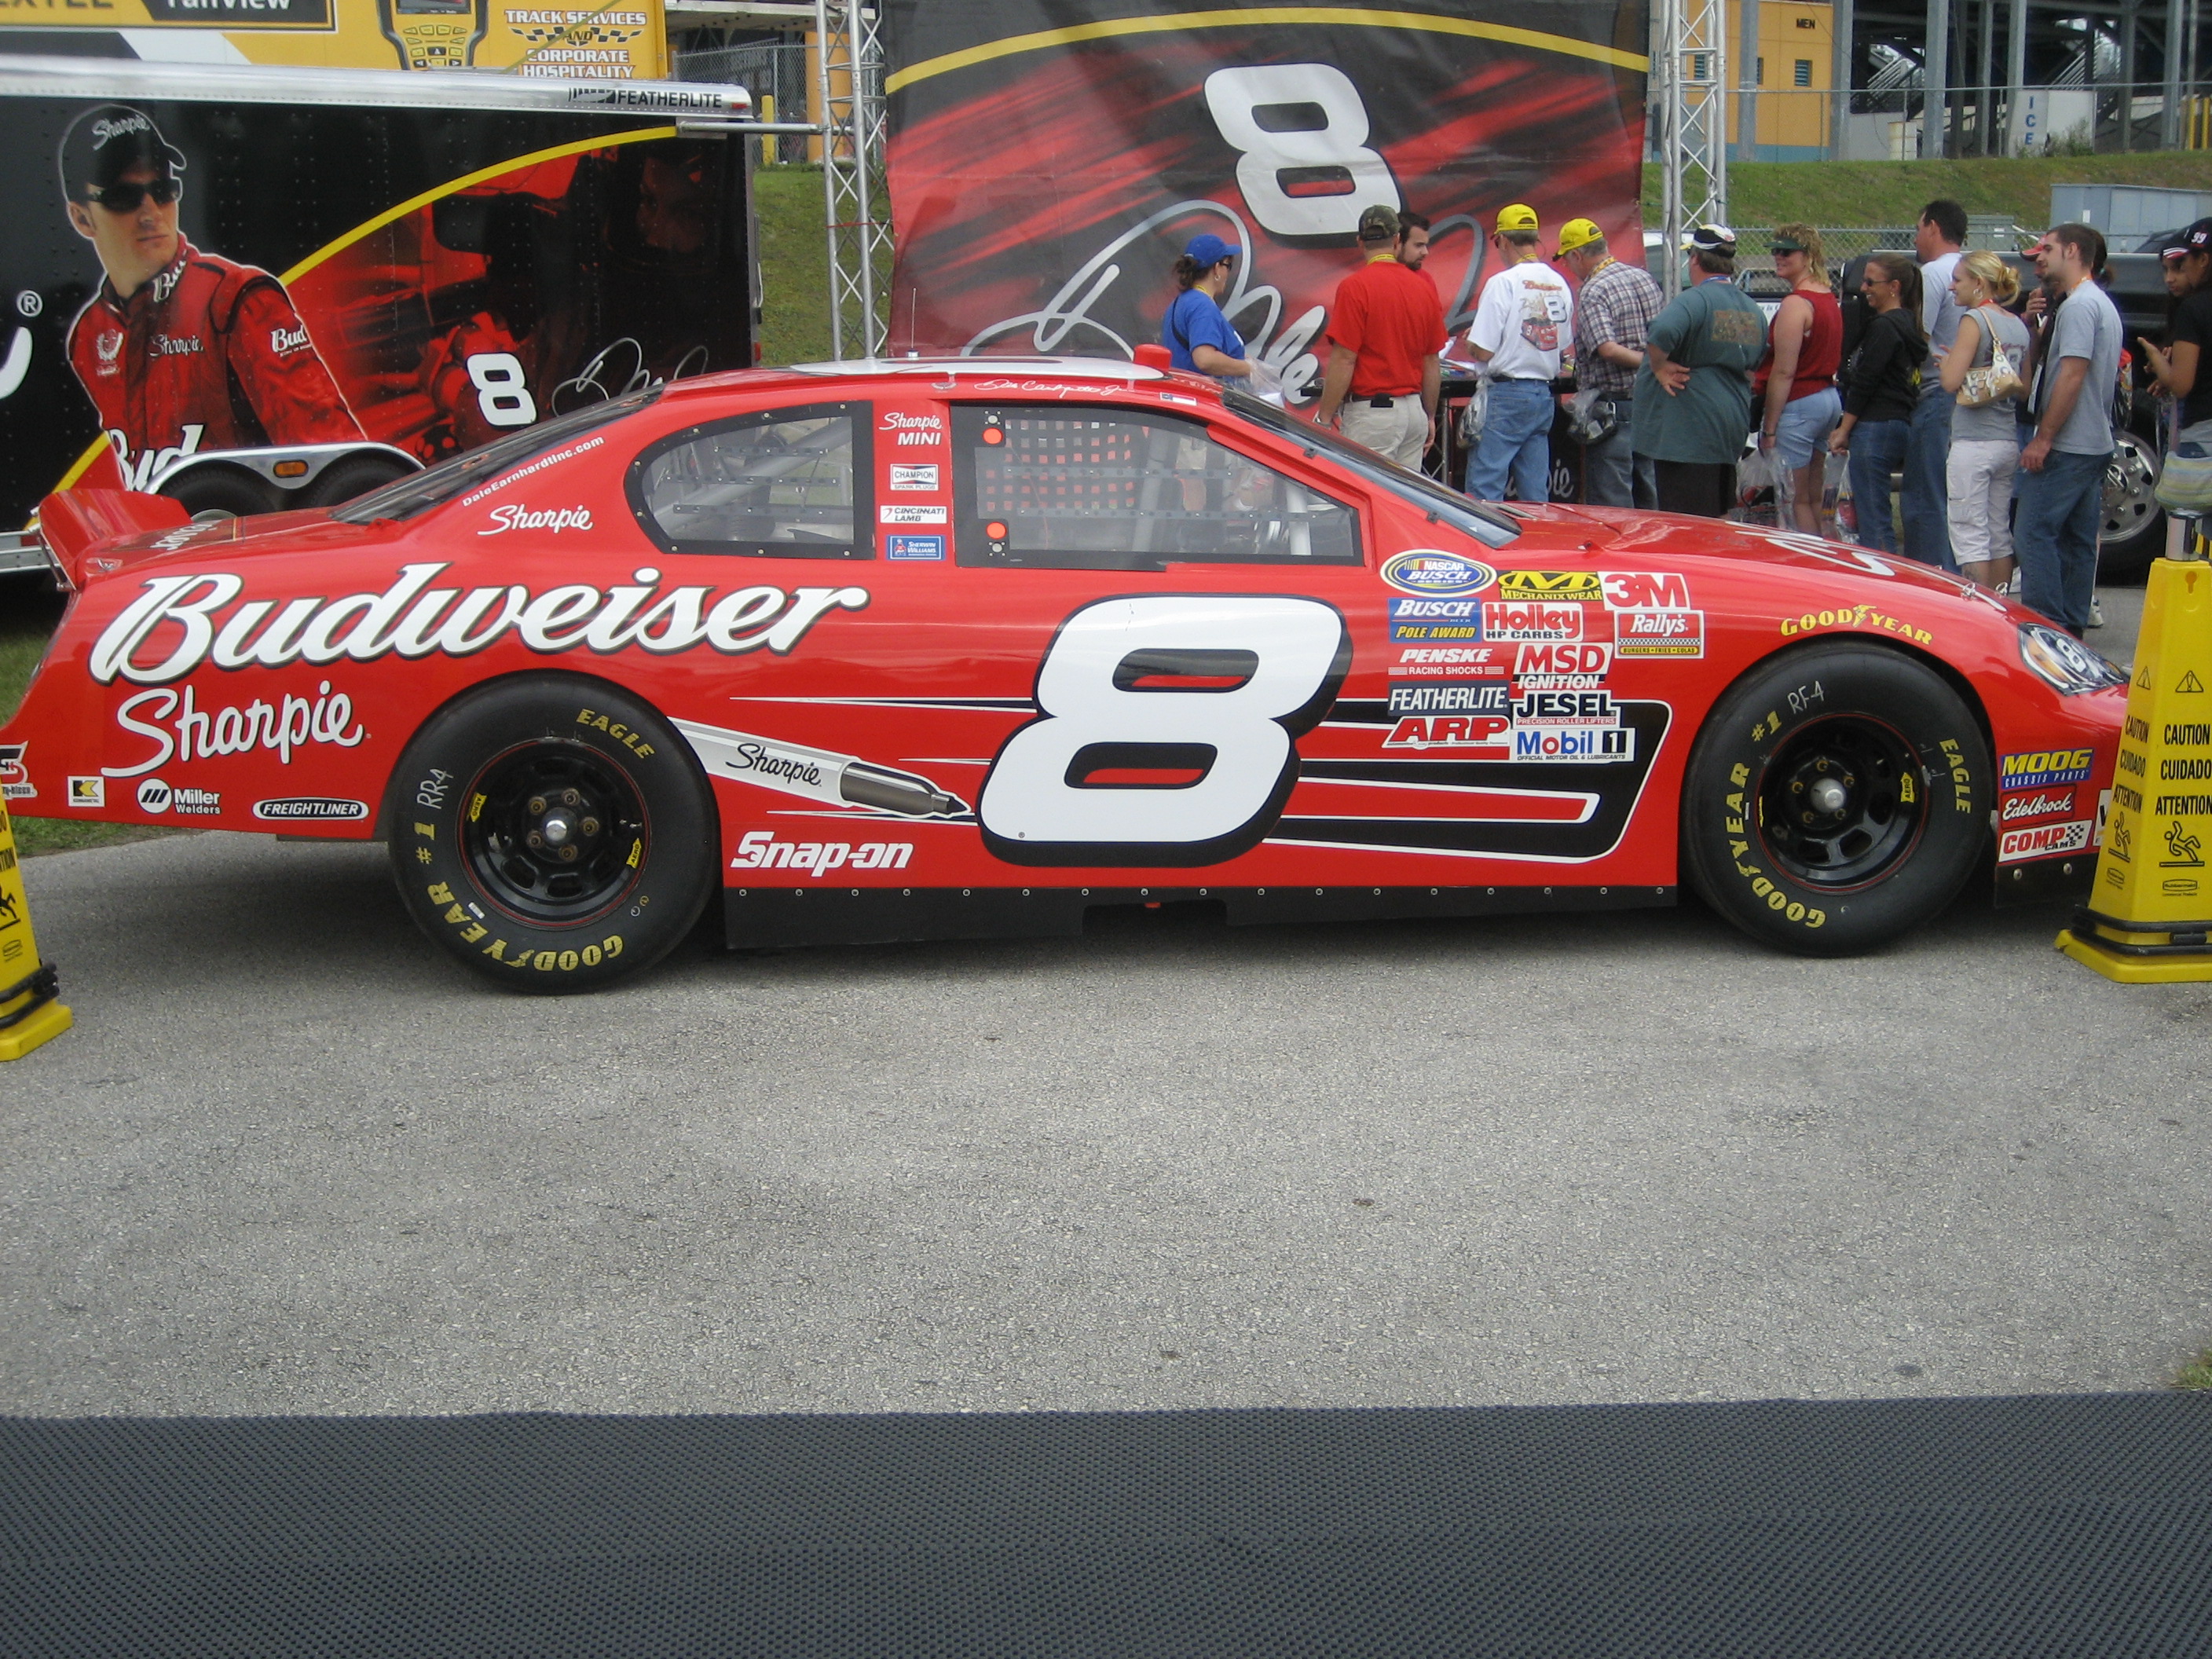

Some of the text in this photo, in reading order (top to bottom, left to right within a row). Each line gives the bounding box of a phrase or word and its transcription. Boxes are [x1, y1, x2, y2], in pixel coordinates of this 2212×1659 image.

[504, 9, 647, 25] TRACK SERVICES
[1796, 18, 1816, 30] MEN
[563, 30, 593, 42] AND
[526, 48, 629, 64] CORPORATE
[520, 64, 635, 79] HOSPITALITY
[617, 90, 723, 108] FEATHERLITE
[1204, 62, 1402, 236] 8
[1543, 295, 1567, 323] 8
[270, 324, 307, 353] Bud
[466, 351, 537, 427] 8
[878, 412, 943, 430] Sharpie
[897, 432, 942, 446] MINI
[462, 436, 605, 507] DaleEarnhardtInc.com
[894, 471, 935, 479] CHAMPION
[476, 504, 594, 536] Sharpie
[894, 507, 945, 515] CINCINNATI
[1406, 571, 1473, 580] BUSCH
[1423, 560, 1465, 571] NASCAR
[1500, 589, 1602, 600] MECHANIX WEAR
[1604, 573, 1688, 608] 3M
[1393, 599, 1476, 617] BUSCH
[89, 562, 870, 685] Budweiser
[1395, 625, 1476, 639] POLE AWARD
[1485, 603, 1580, 639] Holley
[1629, 613, 1686, 637] Rally's
[1780, 603, 1934, 646] GOODYEAR
[1485, 631, 1564, 639] HP CARBS
[1399, 648, 1493, 664] PENSKE
[1519, 644, 1606, 673] MSD
[1408, 666, 1484, 675] RACING SHOCKS
[1517, 675, 1599, 690] IGNITION
[1389, 687, 1508, 711] FEATHERLITE
[1516, 693, 1617, 718] JESEL
[101, 679, 364, 778] Sharpie
[976, 593, 1347, 848] 8
[1389, 717, 1509, 742] ARP
[576, 709, 655, 760] EAGLE
[1517, 731, 1594, 755] Mobil
[2163, 723, 2211, 745] CAUTION
[724, 742, 822, 787] Sharpie
[2001, 749, 2093, 777] MOOG
[2160, 759, 2212, 781] CUIDADO
[1939, 738, 1972, 815] EAGLE
[2005, 769, 2087, 789] CHASSIS PARTS
[174, 788, 221, 804] Miller
[2002, 792, 2073, 821] Edelbrock
[2155, 795, 2212, 815] ATTENTION
[175, 804, 221, 815] Welders
[262, 802, 359, 815] FREIGHTLINER
[1725, 761, 1827, 929] GOODYEAR
[2003, 827, 2067, 855] COMP
[2044, 837, 2078, 852] CAMS
[730, 830, 915, 878] Snap-on
[427, 881, 624, 972] GOODYEAR
